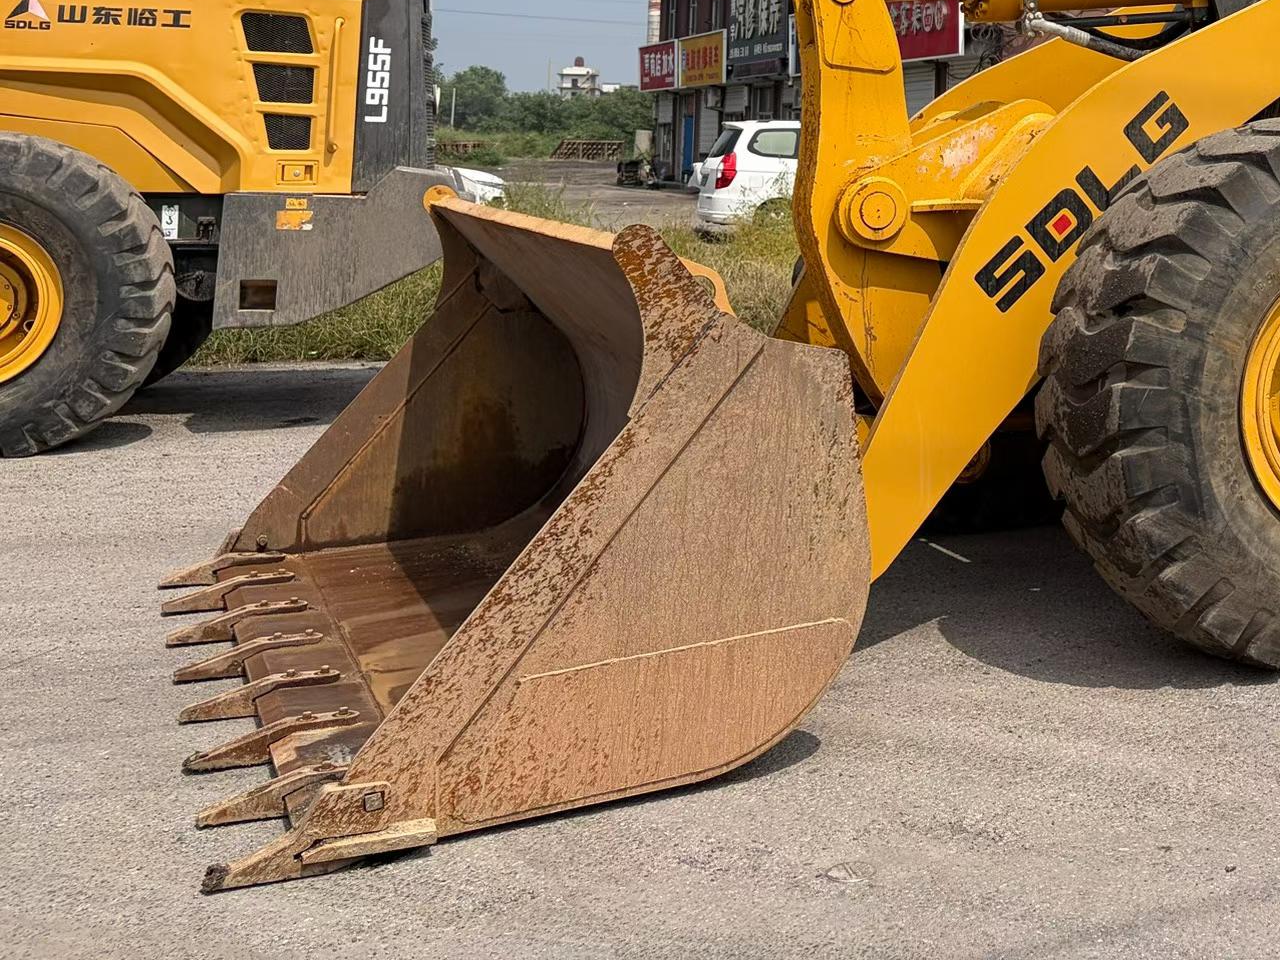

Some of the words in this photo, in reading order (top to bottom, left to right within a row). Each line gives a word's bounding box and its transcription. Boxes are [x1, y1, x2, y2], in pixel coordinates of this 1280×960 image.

[4, 20, 51, 30] SDLG
[57, 4, 192, 28] 山东临工
[364, 36, 392, 122] L955F
[974, 90, 1190, 313] SDLG
